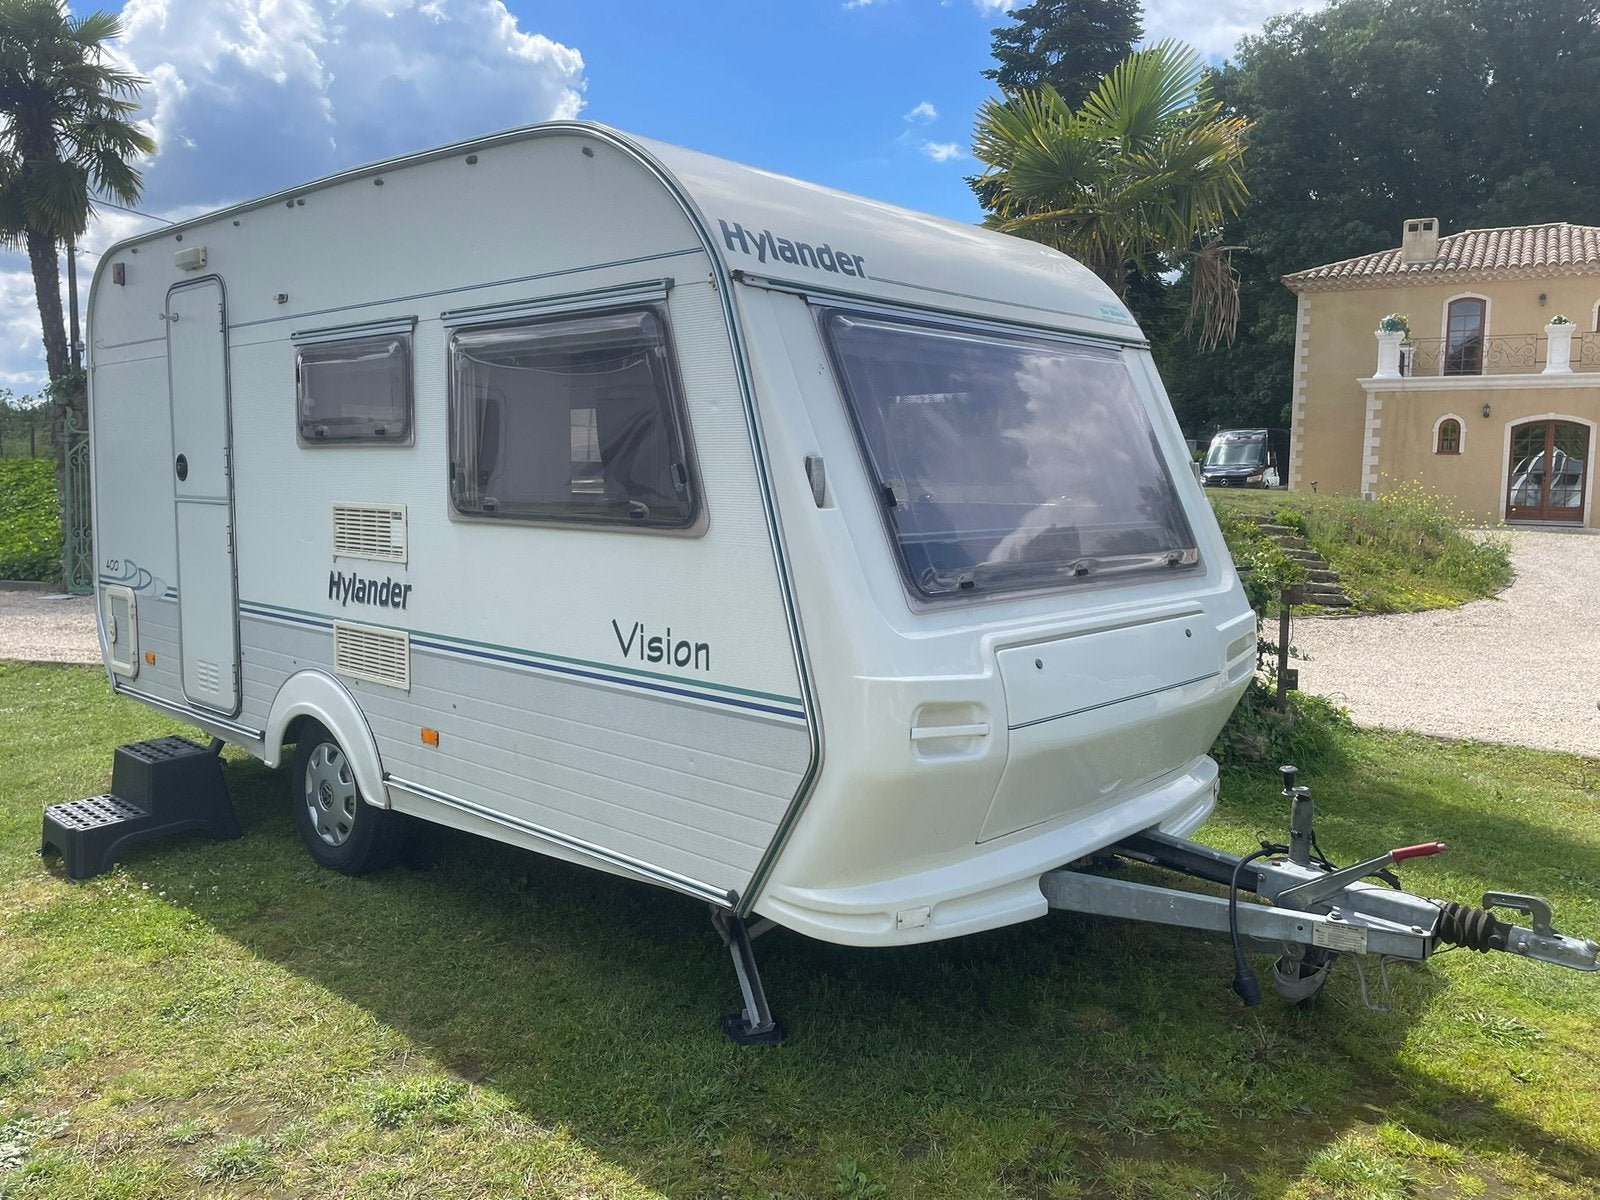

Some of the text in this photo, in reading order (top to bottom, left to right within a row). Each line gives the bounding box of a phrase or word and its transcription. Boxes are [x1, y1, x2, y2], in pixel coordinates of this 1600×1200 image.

[718, 219, 865, 278] Hylander
[106, 559, 119, 571] 400
[328, 570, 413, 610] Hylander
[612, 619, 710, 671] Vision
